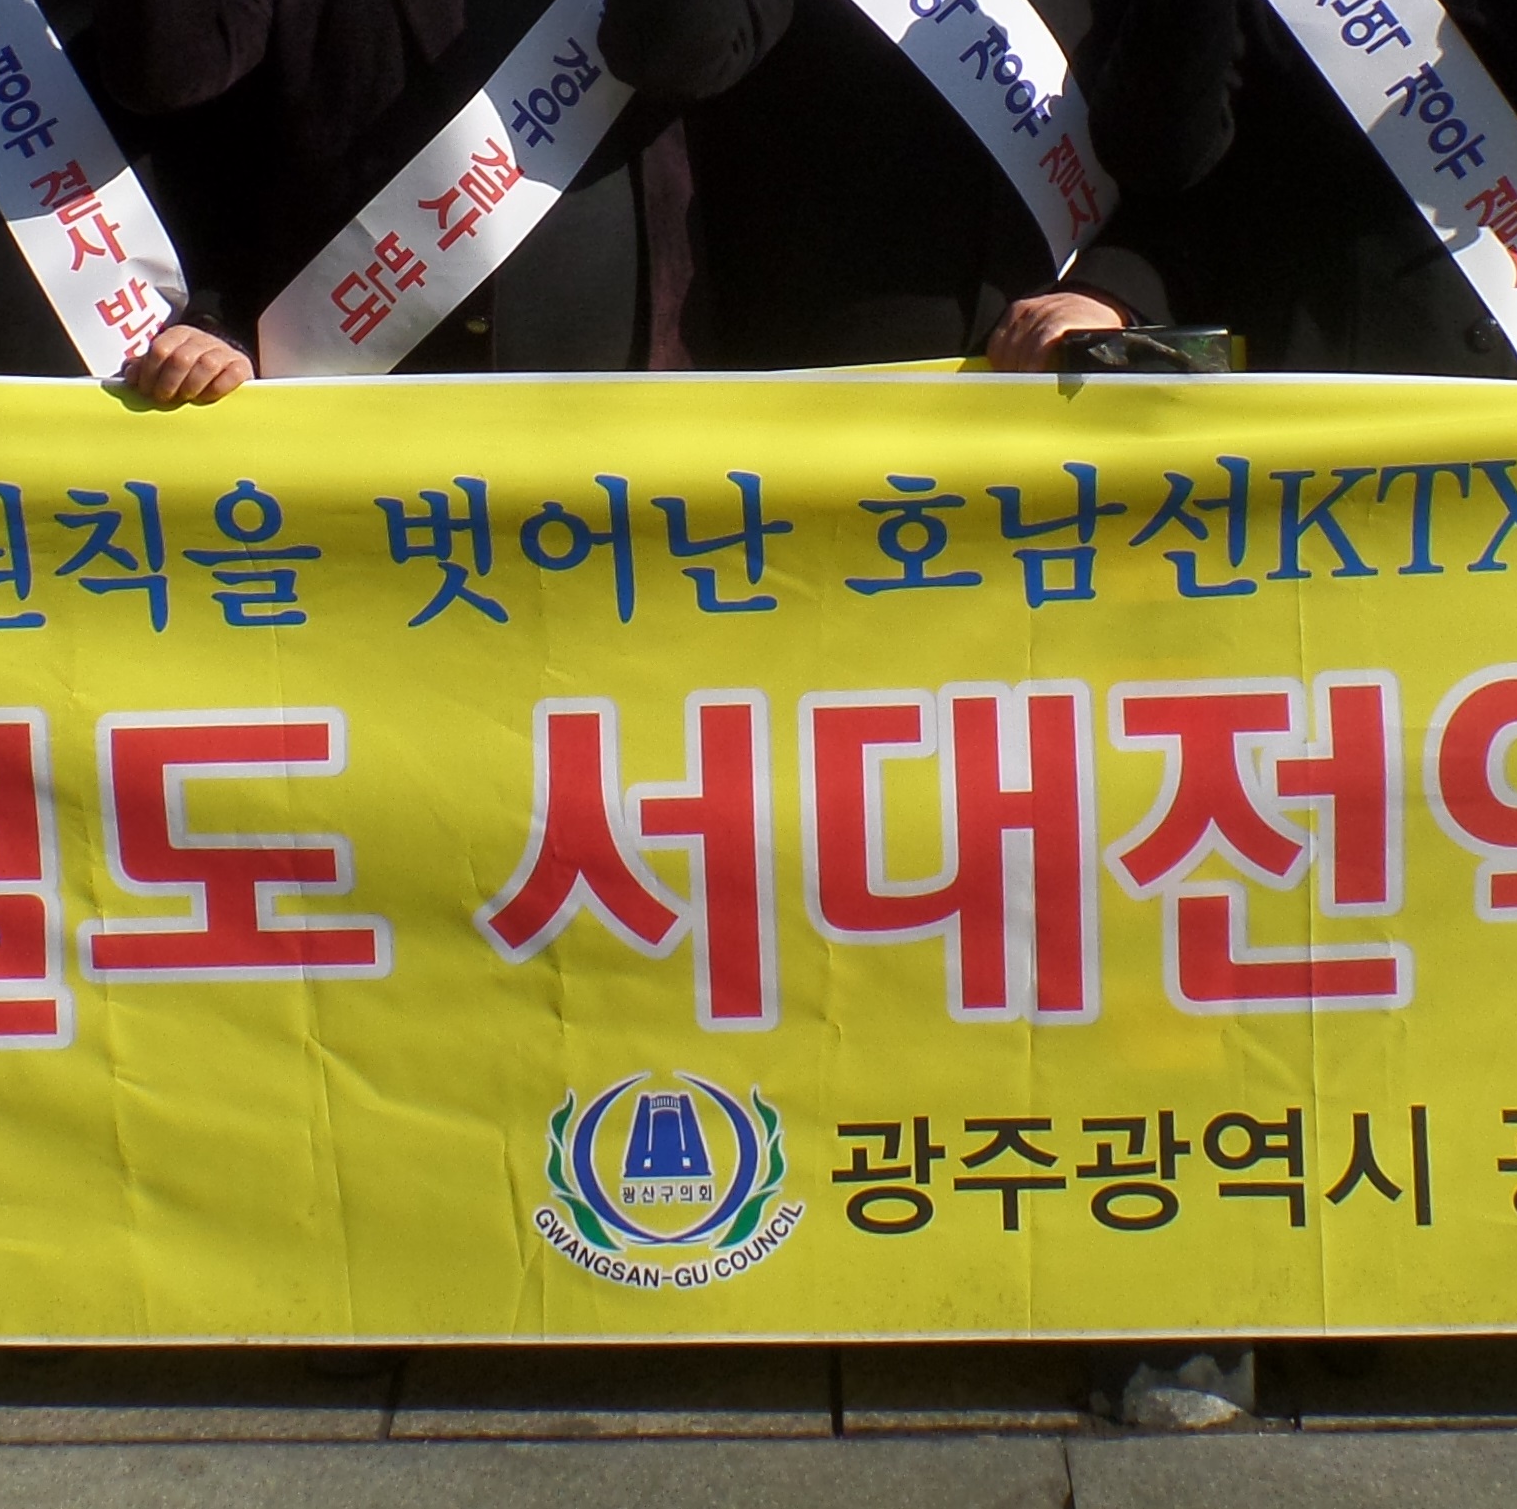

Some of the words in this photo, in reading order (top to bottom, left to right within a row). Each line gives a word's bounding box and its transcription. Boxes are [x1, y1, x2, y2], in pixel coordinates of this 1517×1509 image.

[508, 36, 603, 150] 경유
[959, 25, 1053, 138] 경유
[1037, 133, 1102, 240] 결사
[1384, 62, 1485, 180] 경유
[29, 160, 123, 272] 결사
[416, 137, 525, 252] 결사
[328, 229, 429, 346] 반대
[374, 470, 795, 630] 벗어난
[829, 1105, 1434, 1235] 광주광역시
[535, 1207, 710, 1288] GWANGSAN-GU
[713, 1202, 804, 1278] COUNCIL
